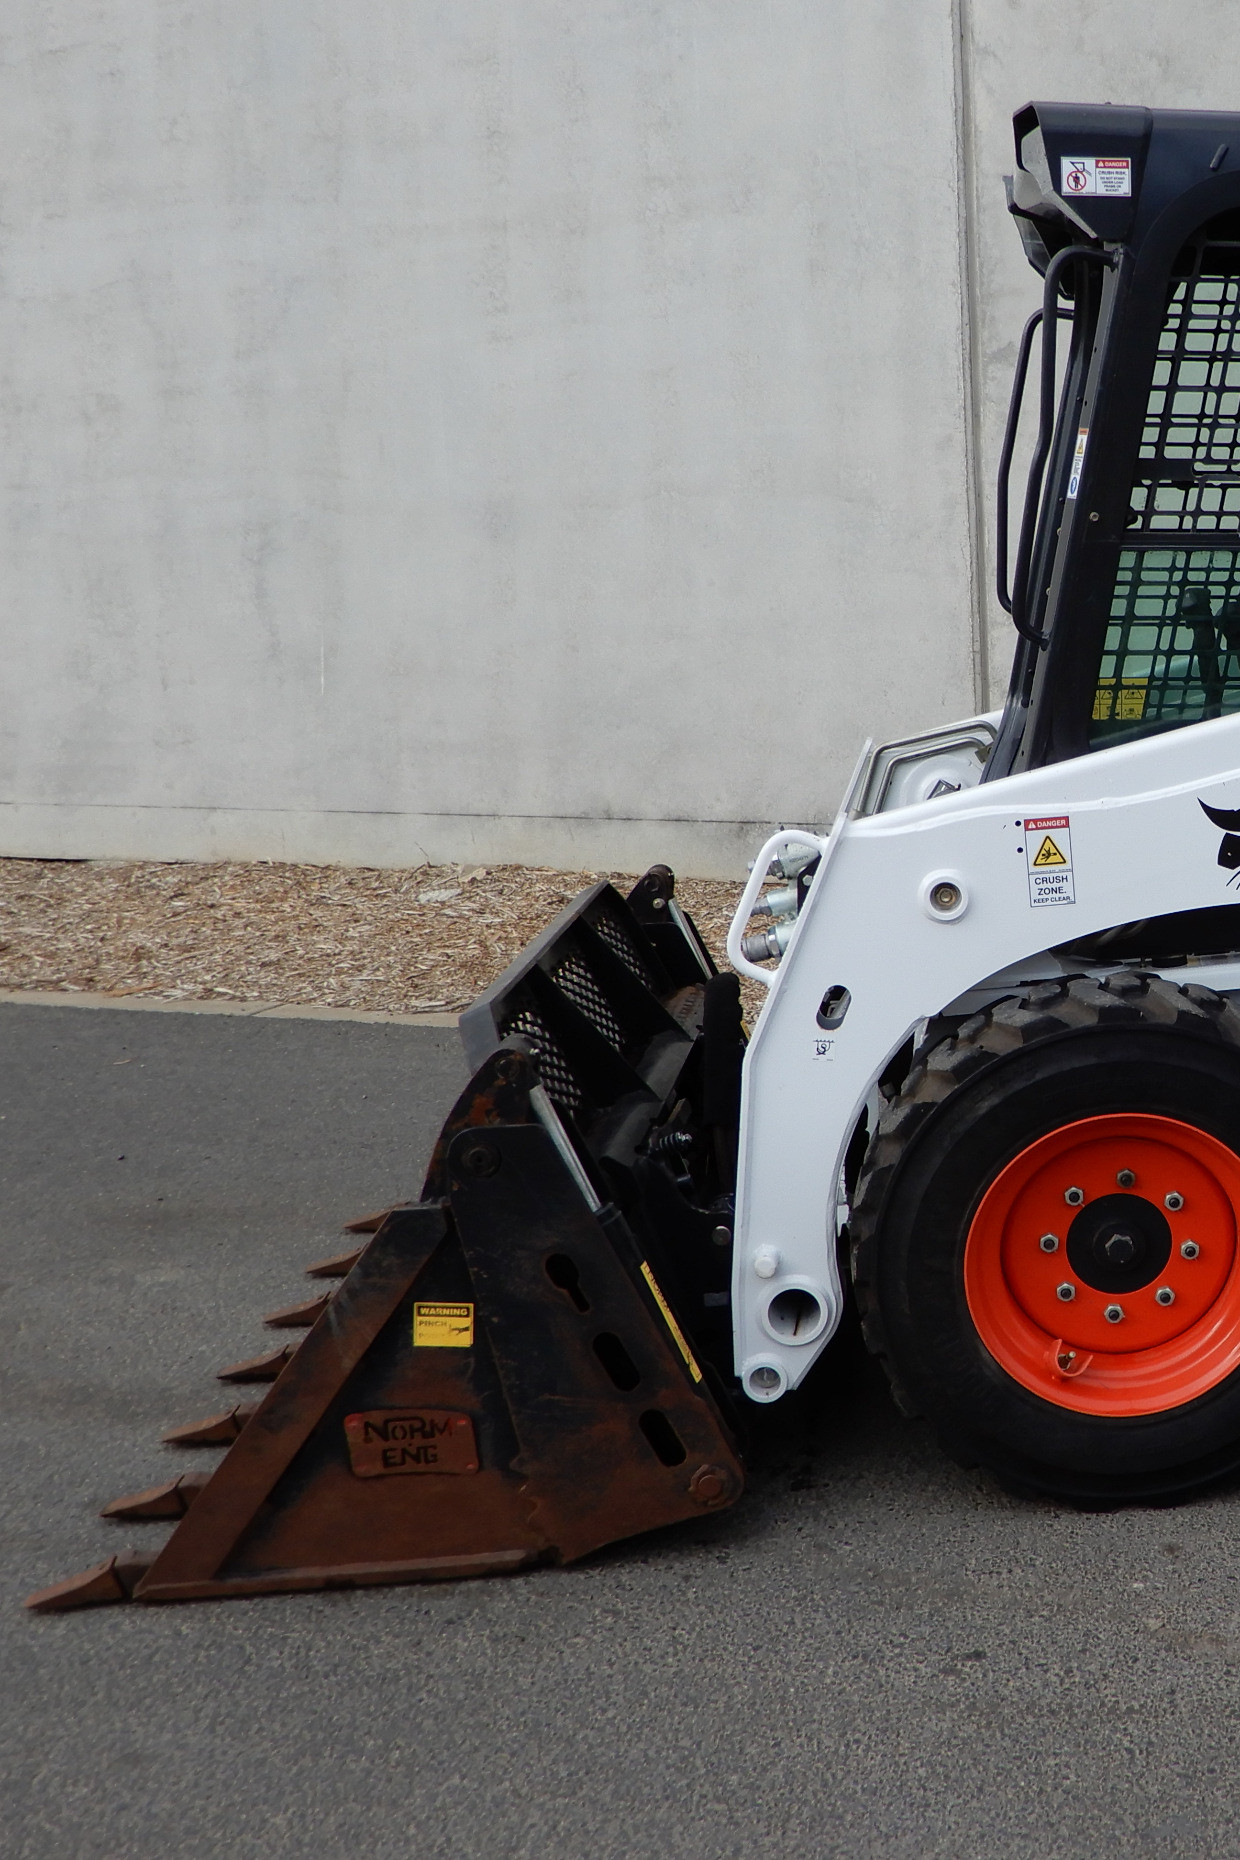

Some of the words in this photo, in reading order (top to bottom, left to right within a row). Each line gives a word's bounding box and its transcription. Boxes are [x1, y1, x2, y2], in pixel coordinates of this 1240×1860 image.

[1037, 820, 1066, 828] DANGER
[1034, 875, 1069, 885] CRUSH
[1037, 886, 1067, 896] ZONE.
[1050, 895, 1072, 903] CLEAR.
[419, 1307, 468, 1316] WARNING
[363, 1416, 453, 1444] NORM
[381, 1445, 438, 1469] ENG
